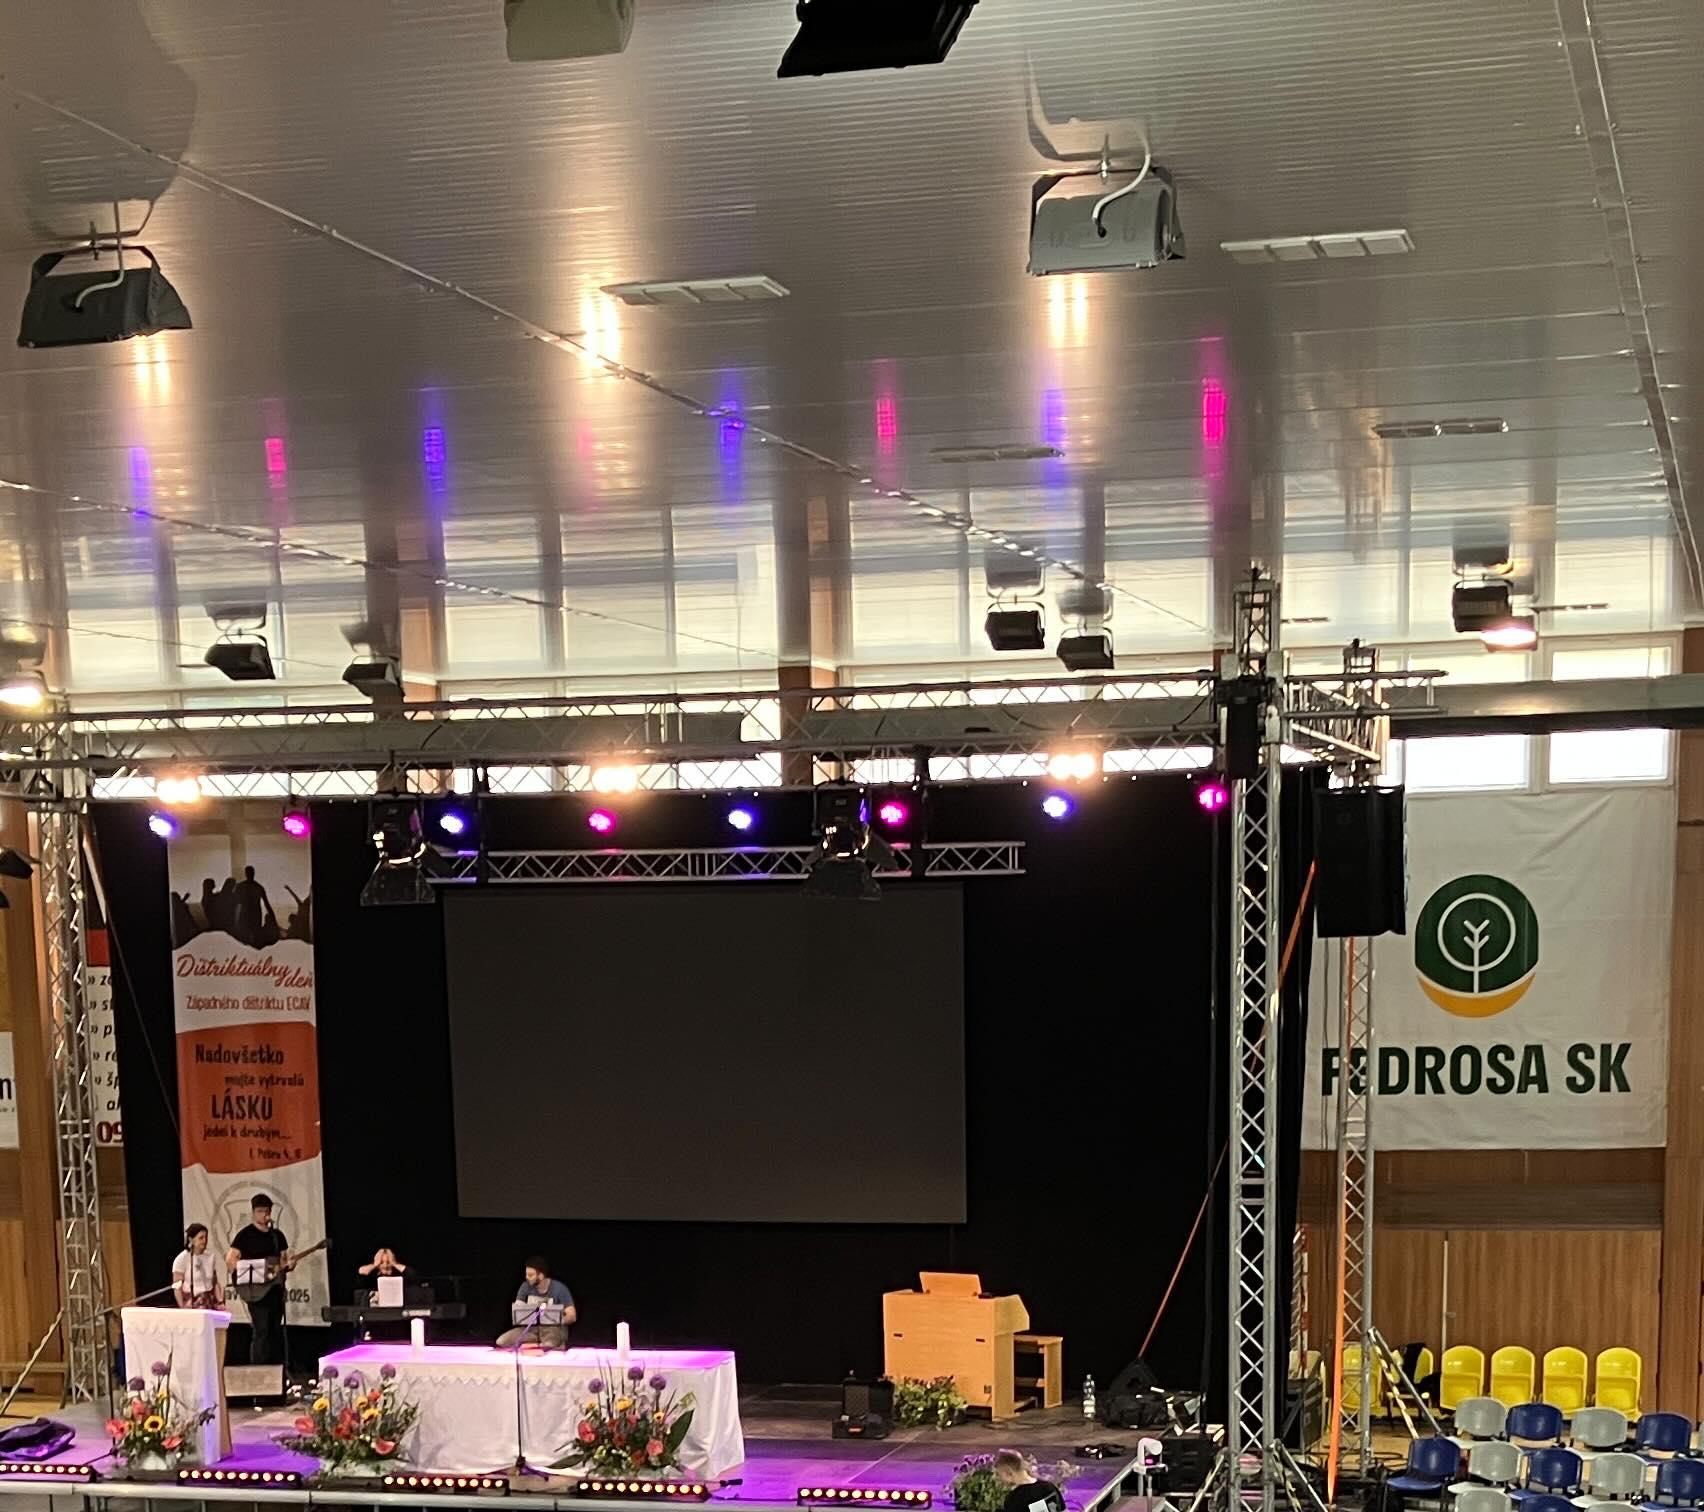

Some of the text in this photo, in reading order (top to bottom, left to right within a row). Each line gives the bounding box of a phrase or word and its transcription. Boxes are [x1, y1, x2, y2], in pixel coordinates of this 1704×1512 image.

[195, 1044, 284, 1065] Nadovšetko
[1565, 1042, 1632, 1095] SK
[210, 1088, 273, 1120] LÁSKU
